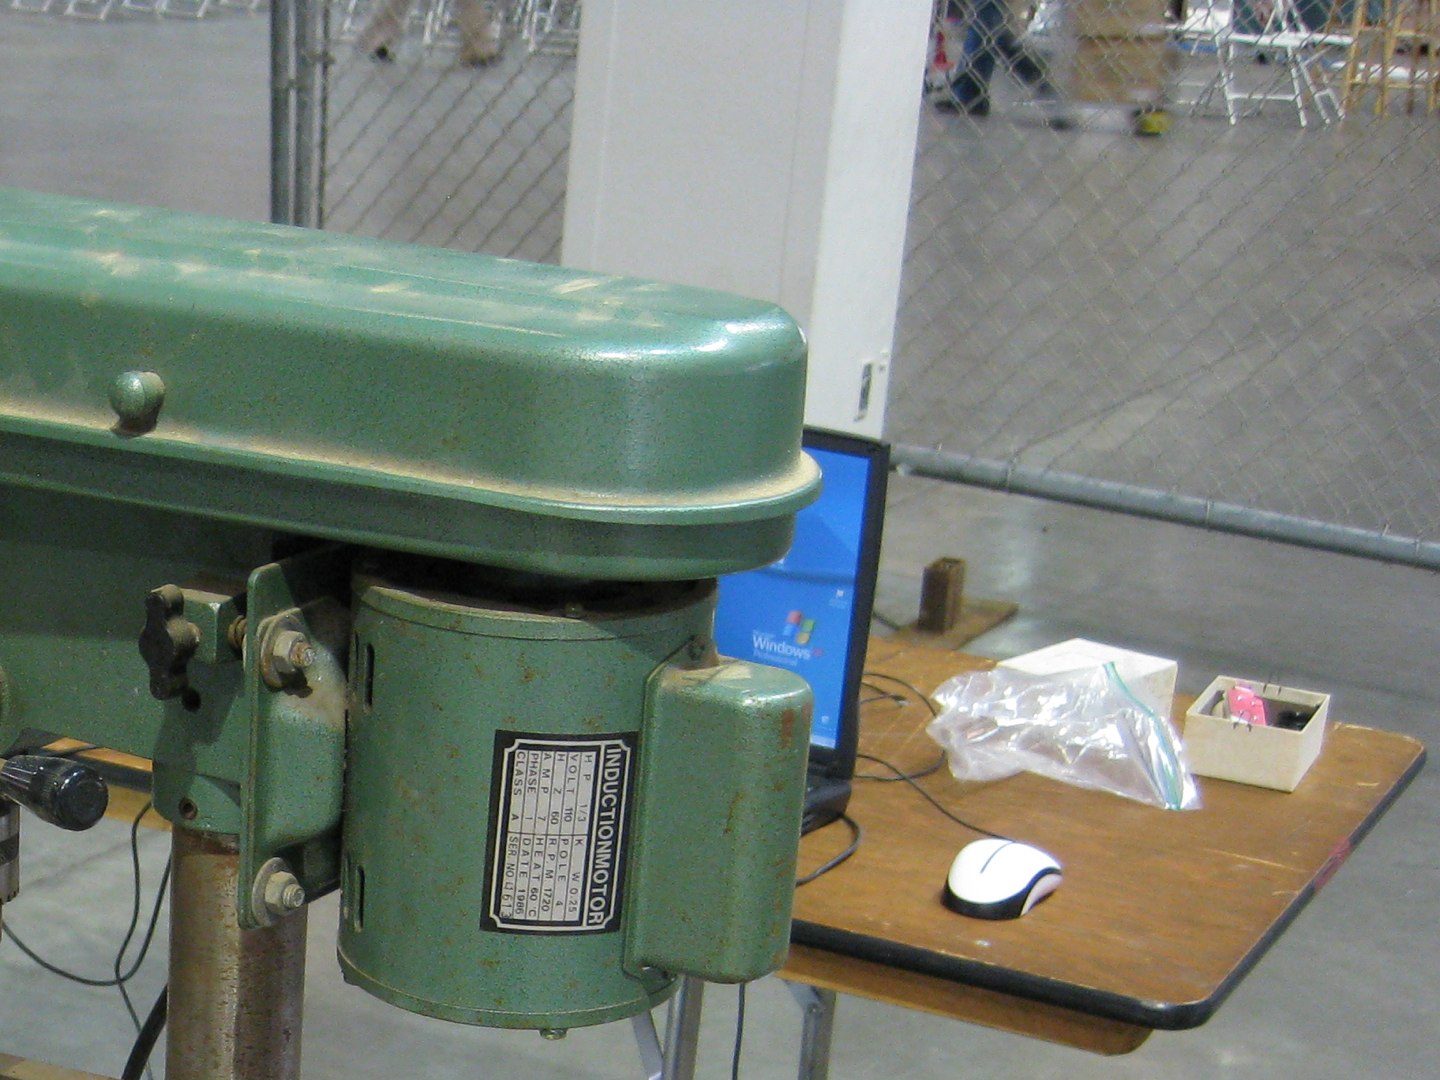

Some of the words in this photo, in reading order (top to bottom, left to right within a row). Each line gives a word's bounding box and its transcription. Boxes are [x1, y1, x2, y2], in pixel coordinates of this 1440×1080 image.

[513, 752, 525, 796] CLASS
[527, 753, 538, 793] PHASE
[541, 753, 552, 794] AMP
[567, 754, 579, 793] VOLT
[511, 813, 519, 821] A
[550, 811, 559, 825] 60
[564, 807, 573, 822] 110
[577, 804, 588, 822] 1/3
[519, 838, 531, 878] DATE
[532, 837, 543, 881] HEAT
[558, 838, 569, 881] POLE
[515, 889, 525, 915] 1986
[530, 887, 538, 901] 60
[541, 888, 552, 911] 1720
[568, 888, 579, 912] 0.25
